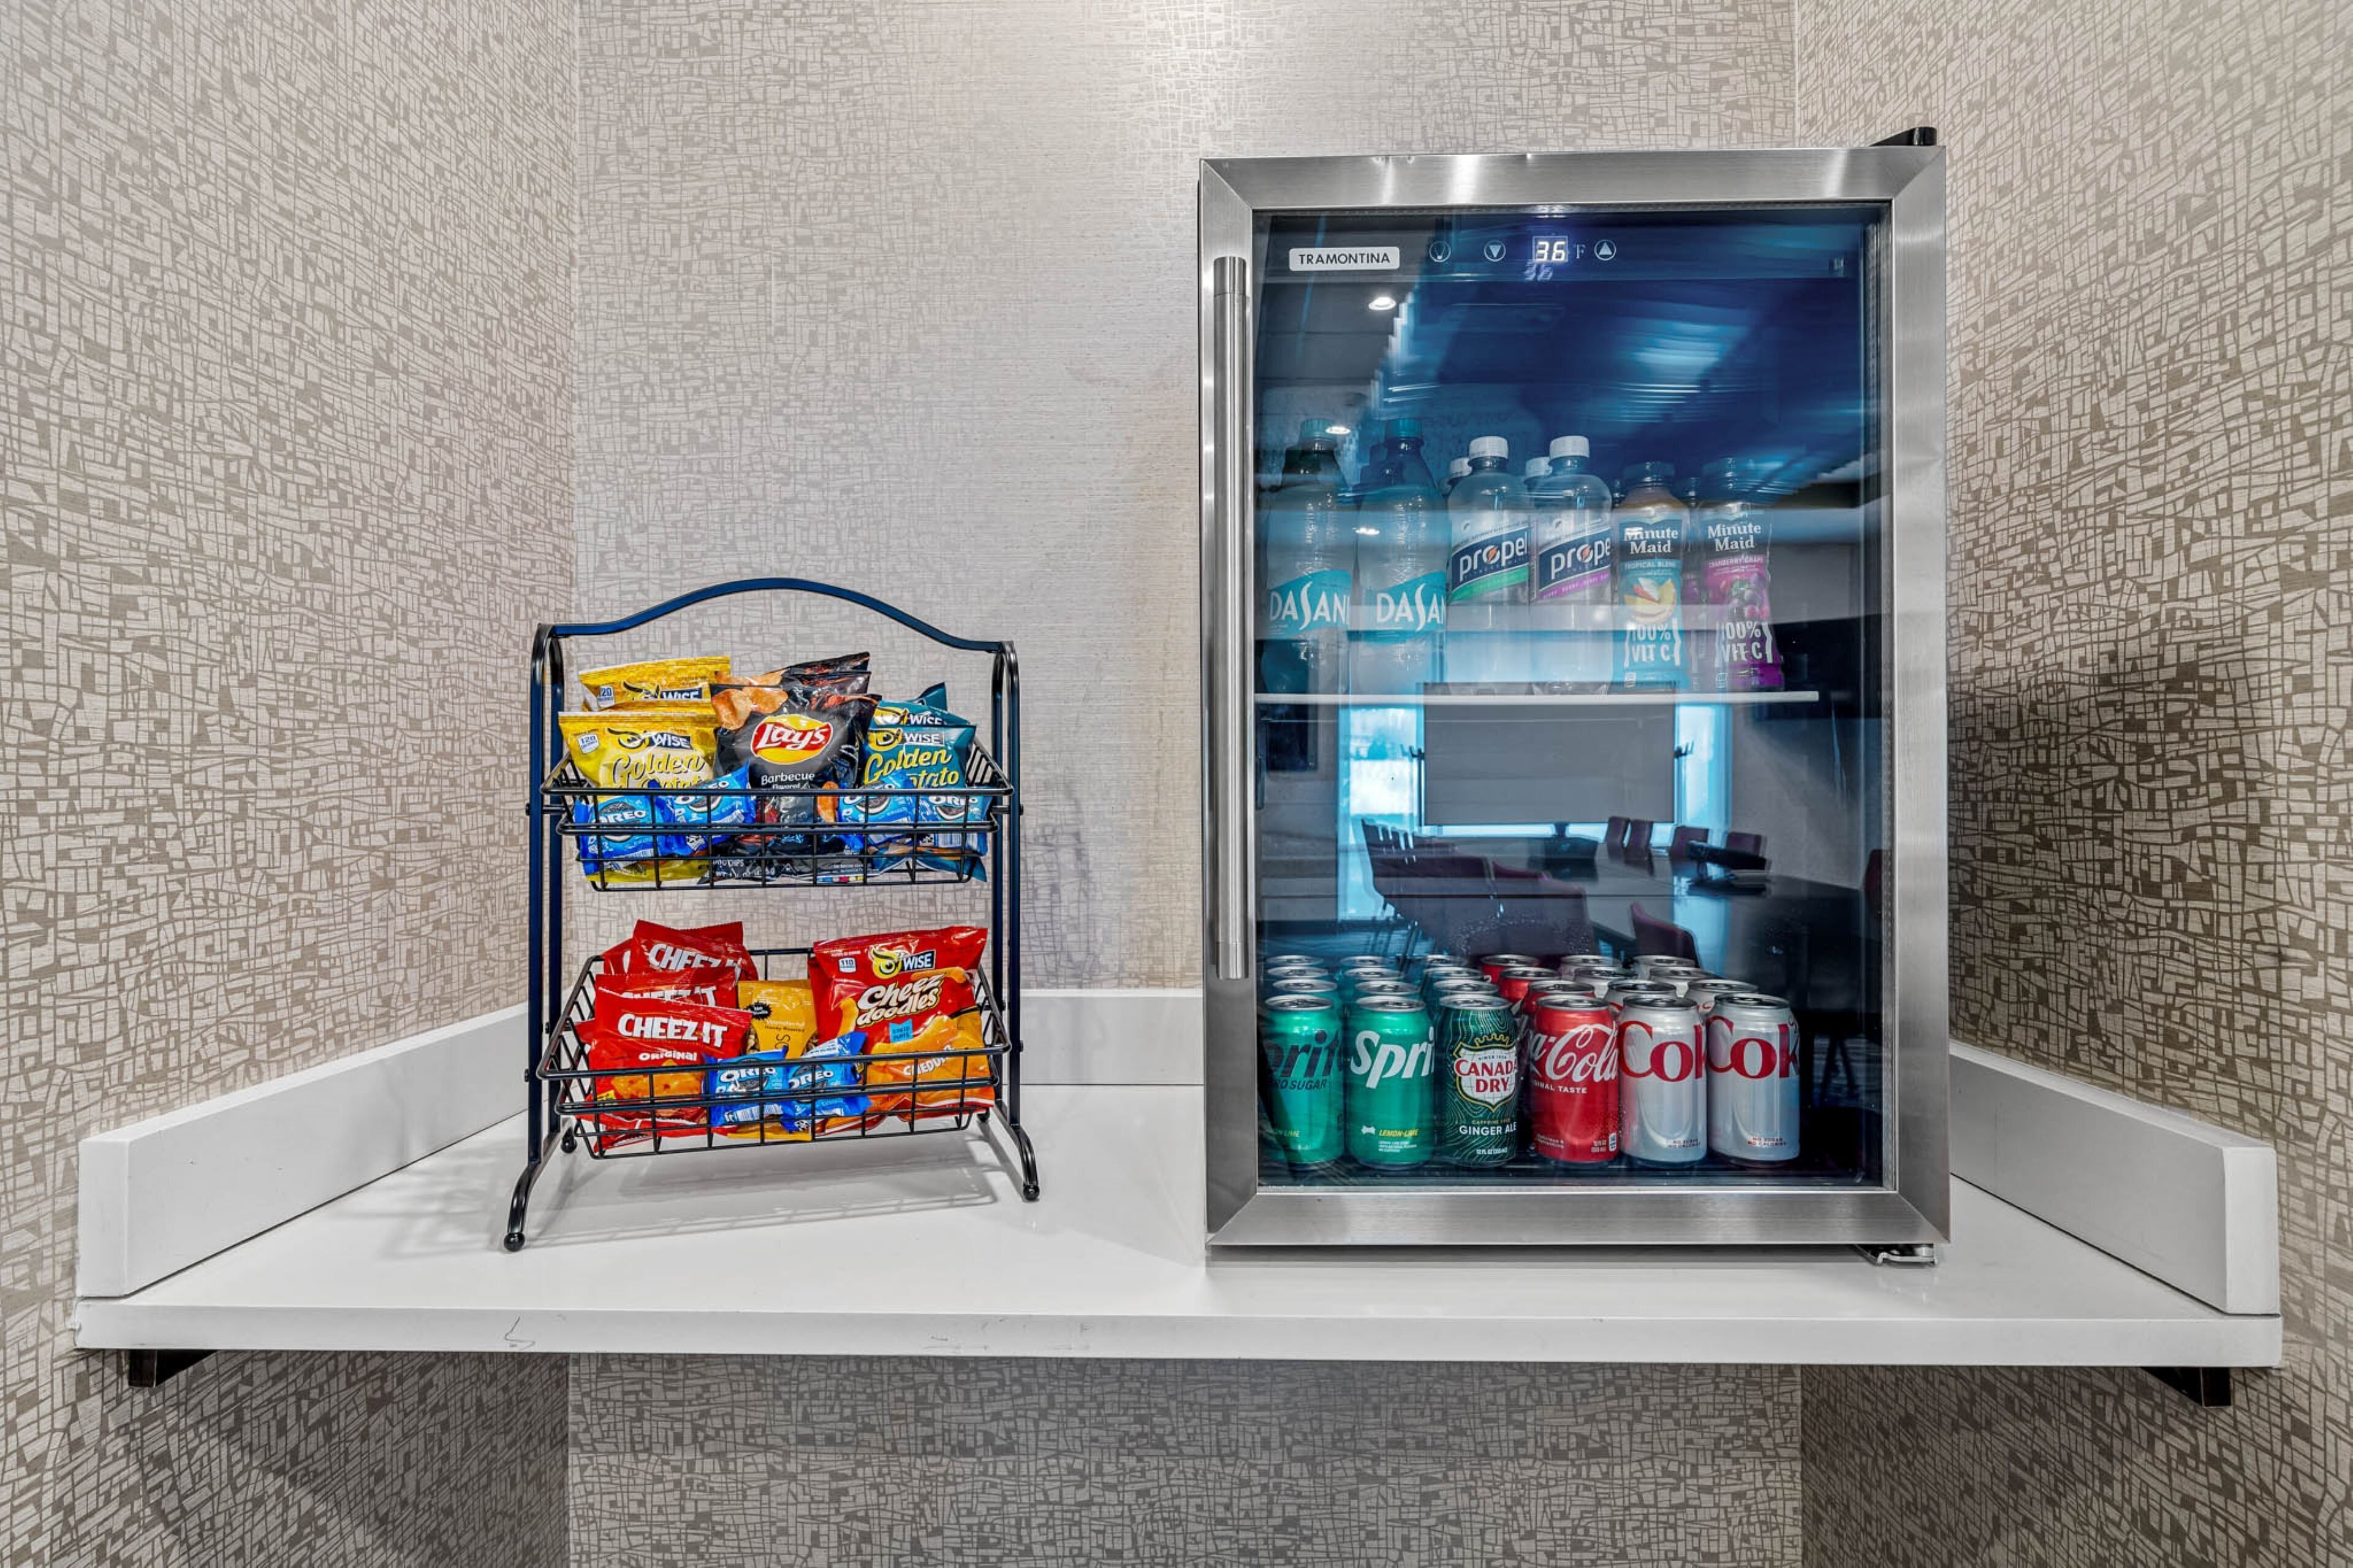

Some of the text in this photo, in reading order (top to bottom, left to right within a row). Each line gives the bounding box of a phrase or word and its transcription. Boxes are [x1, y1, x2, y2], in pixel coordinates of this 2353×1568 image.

[1298, 252, 1390, 265] TRAMONTINA
[1535, 241, 1566, 262] 36
[1708, 523, 1761, 539] Minute
[1630, 541, 1671, 554] Maid
[1715, 535, 1754, 551] Maid
[1459, 531, 1527, 582] propel
[1632, 643, 1671, 662] VIT C
[1751, 642, 1762, 659] C
[652, 733, 688, 747] WISE
[756, 724, 828, 751] Lay's
[904, 732, 940, 743] WISE
[613, 752, 705, 788] Golden
[863, 748, 952, 784] Golden
[761, 772, 815, 786] Barbecue
[903, 953, 933, 971] WISE
[857, 973, 947, 1011] Cheez
[856, 988, 939, 1027] doodles
[1350, 1026, 1434, 1089] Spri
[1291, 1079, 1328, 1091] SUGAR
[1475, 1078, 1509, 1093] DRY
[1558, 1086, 1587, 1094] TASTE
[1459, 1122, 1517, 1135] GINGER ALE
